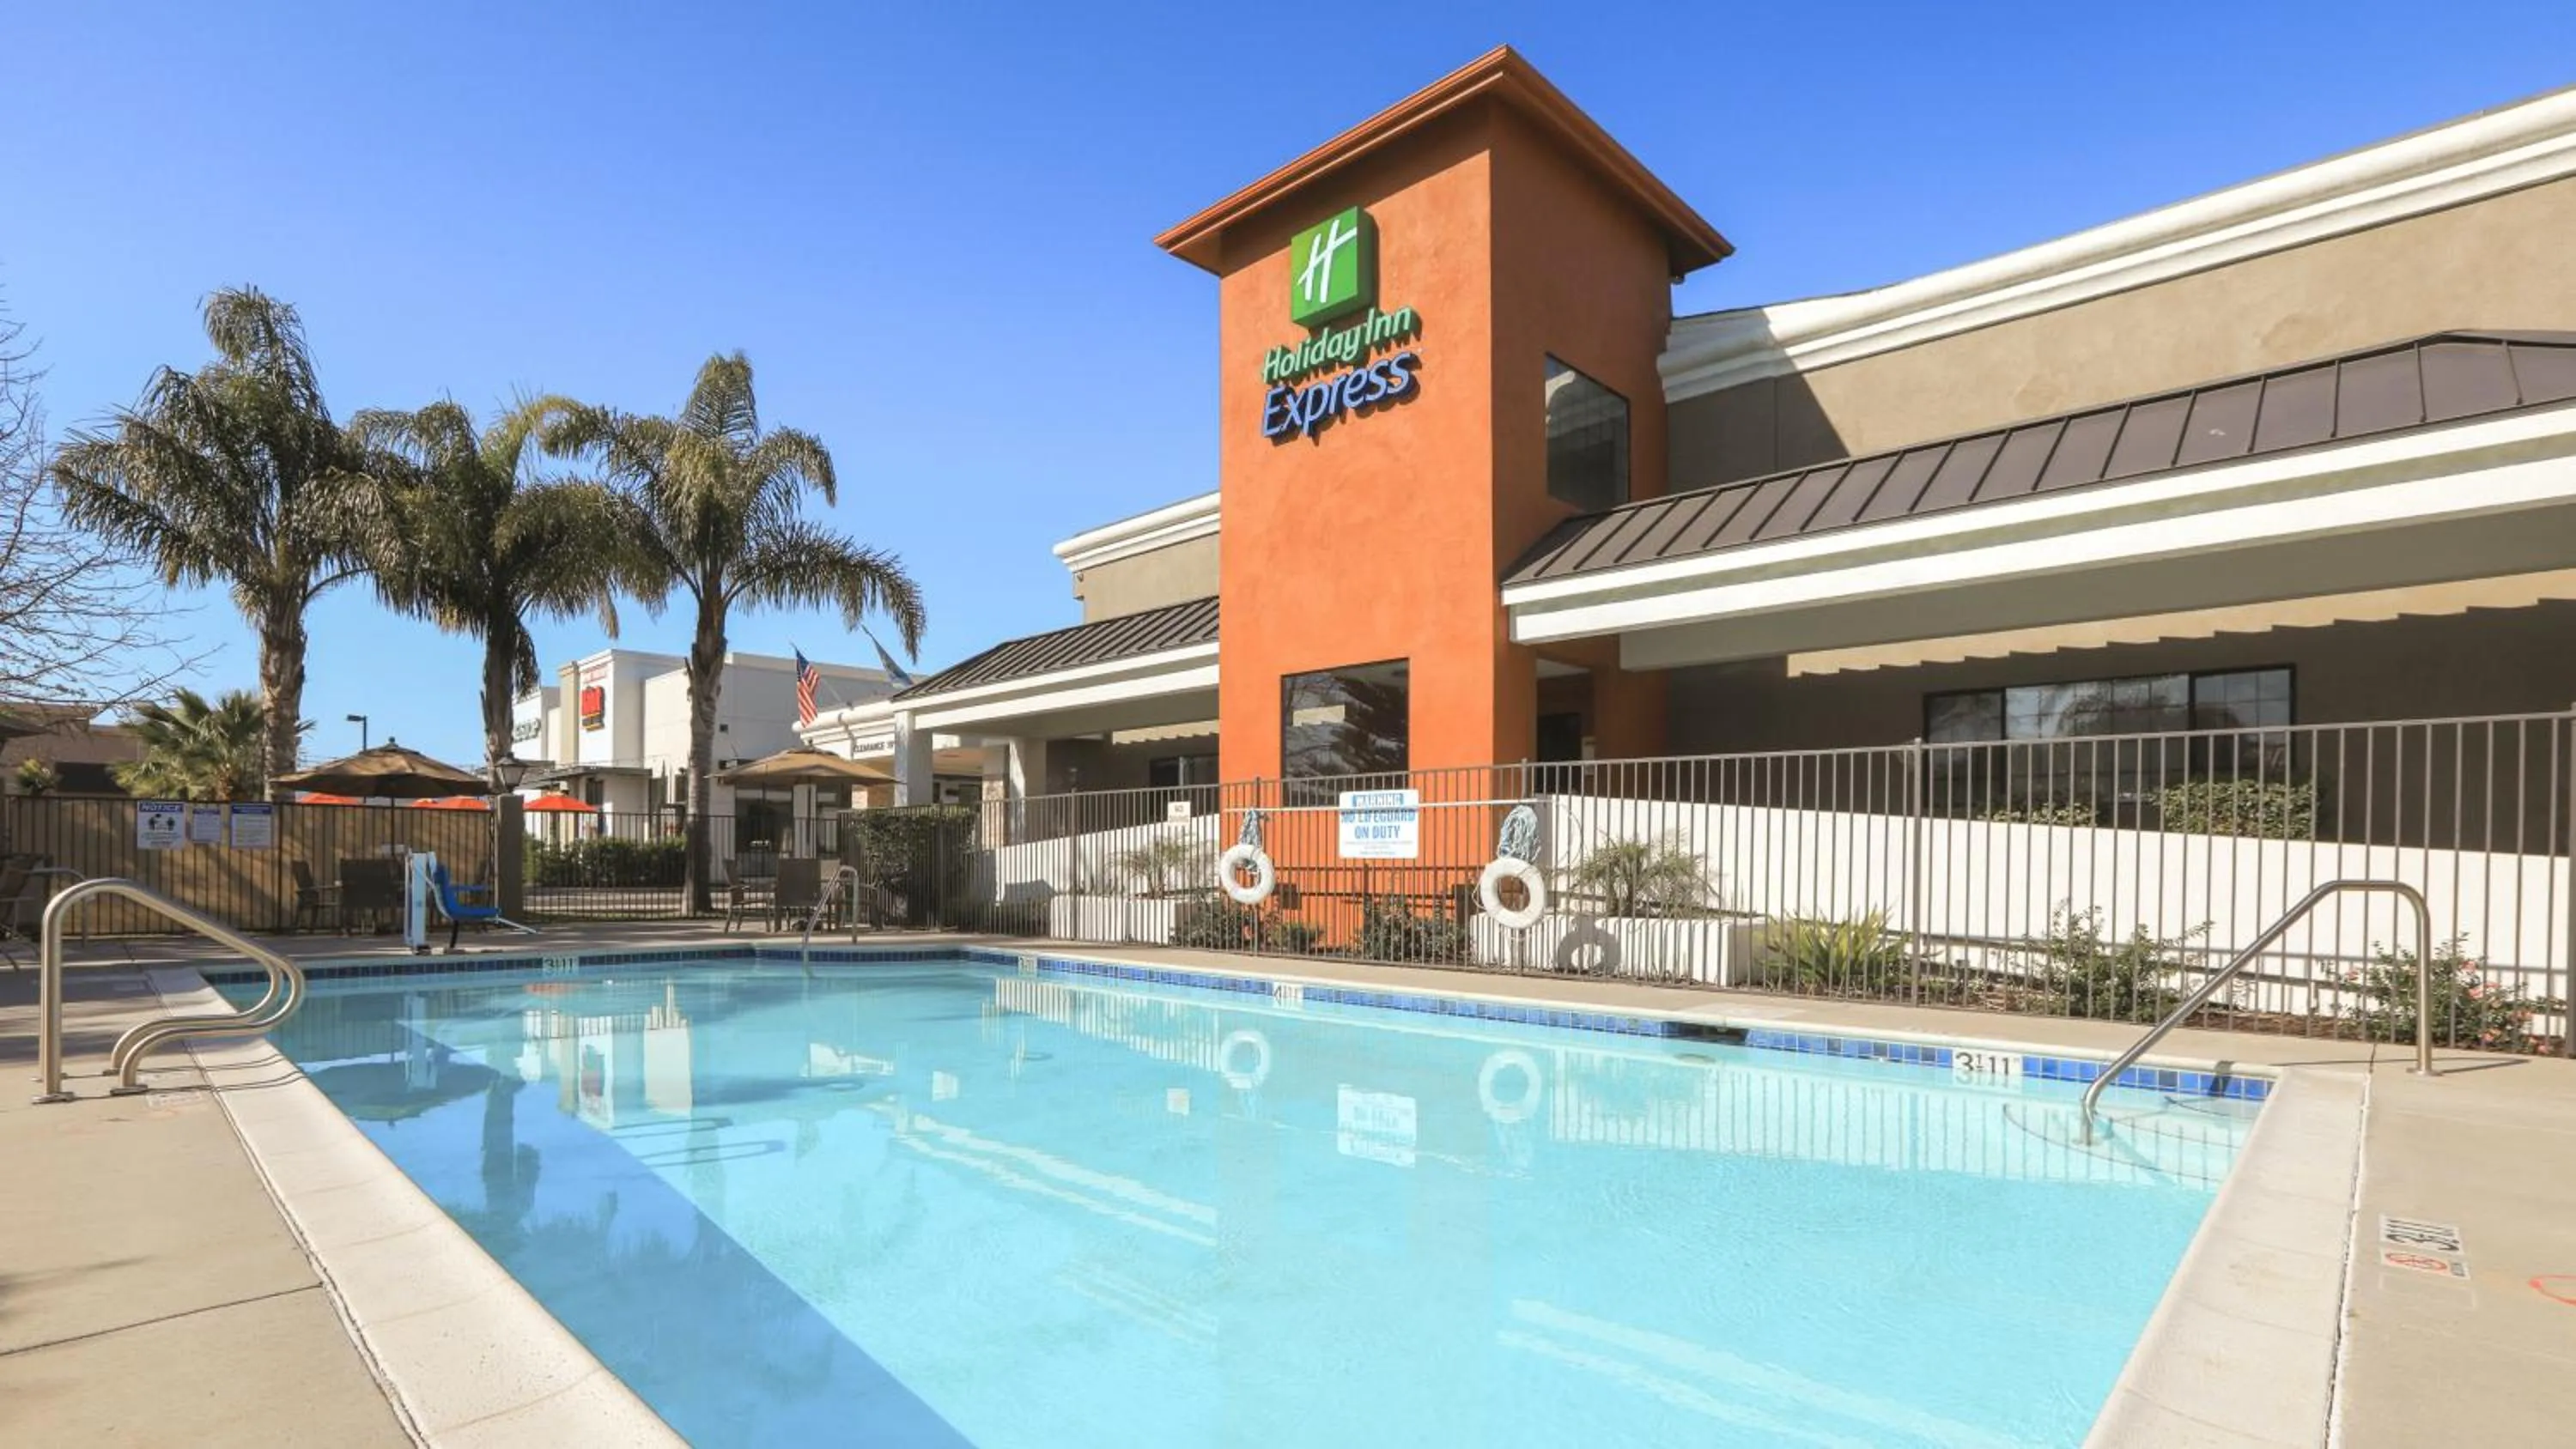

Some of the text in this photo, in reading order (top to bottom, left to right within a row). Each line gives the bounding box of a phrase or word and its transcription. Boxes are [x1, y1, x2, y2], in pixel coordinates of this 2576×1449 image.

[1262, 307, 1413, 383] Holiday Inn
[1262, 352, 1413, 439] Express
[141, 803, 180, 812] NOTICE
[1354, 793, 1403, 807] WARNING
[1341, 808, 1416, 823] NO LIFEGUARD
[1354, 825, 1401, 840] ON DUTY
